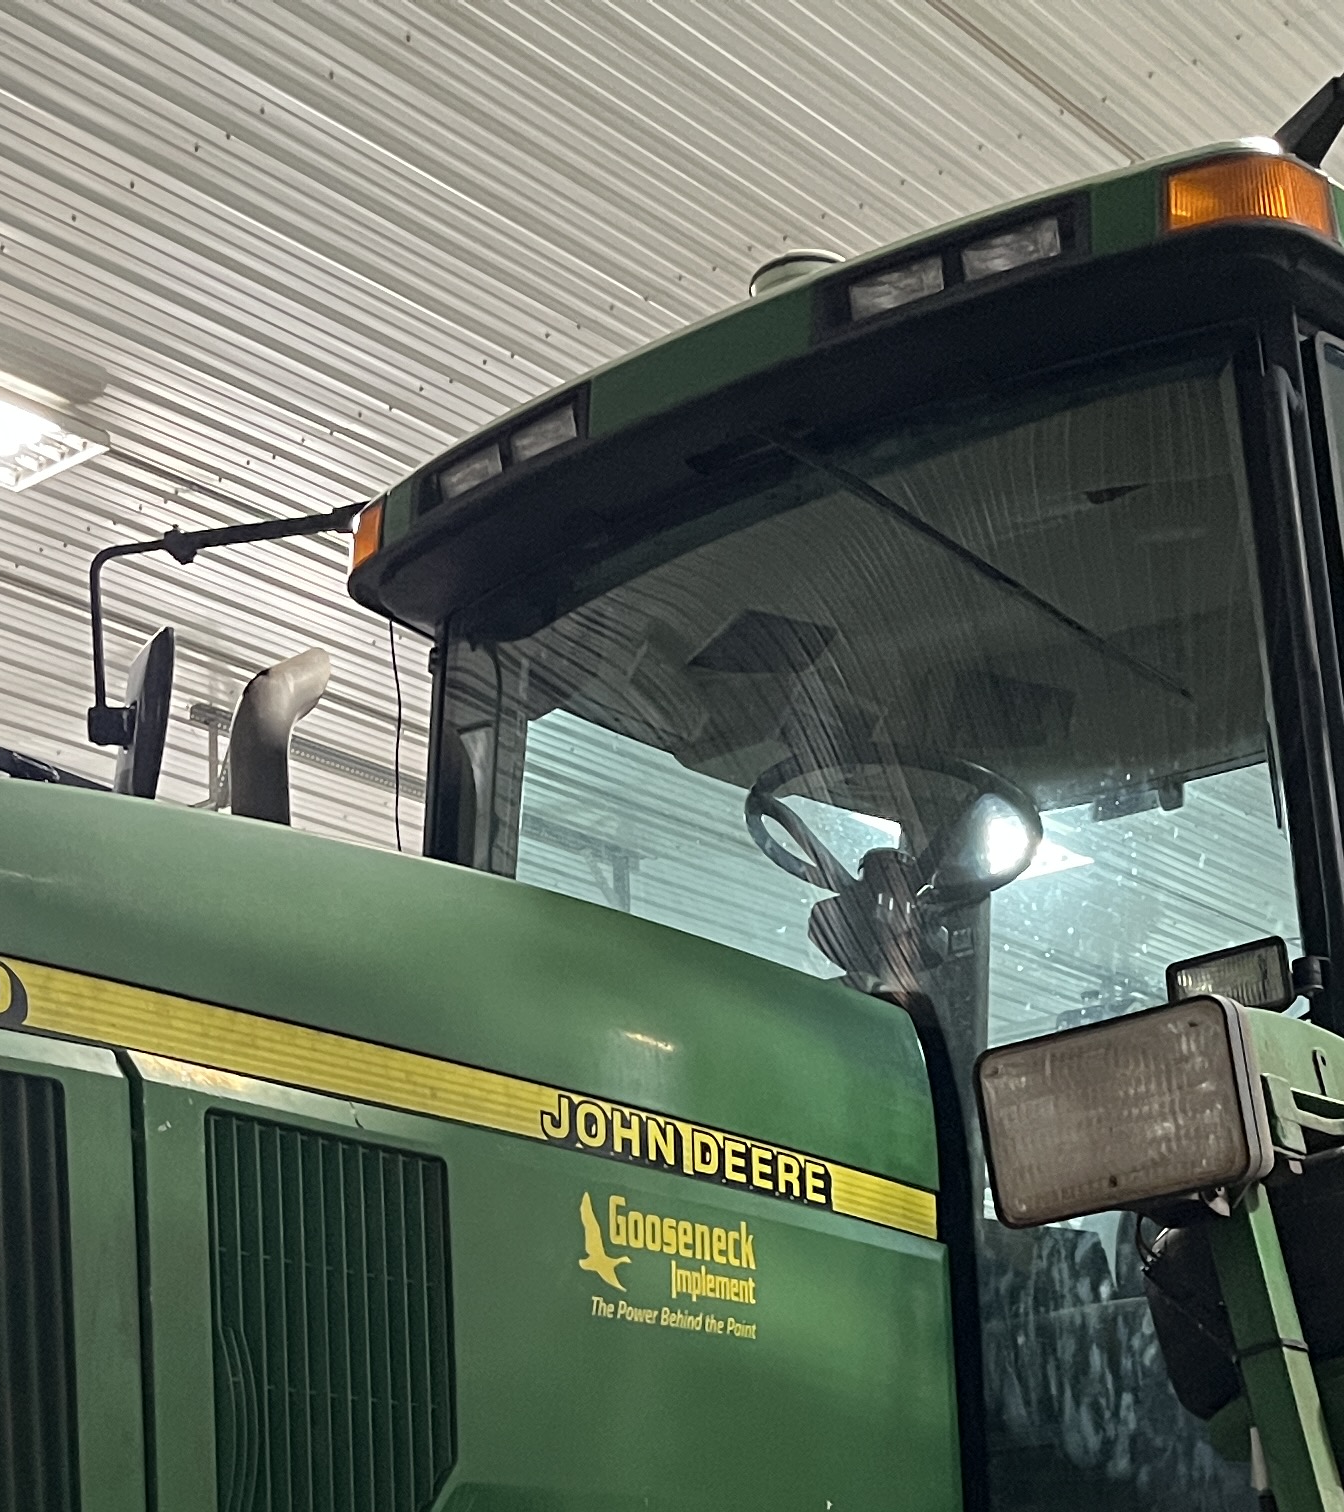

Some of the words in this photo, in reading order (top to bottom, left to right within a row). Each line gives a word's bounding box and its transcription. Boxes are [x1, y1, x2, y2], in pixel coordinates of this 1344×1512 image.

[540, 1094, 677, 1169] JOHN
[692, 1130, 828, 1206] DEERE
[609, 1195, 756, 1269] Gooseneck
[671, 1260, 756, 1304] Implement
[591, 1296, 614, 1318] The
[617, 1300, 659, 1325] Power
[660, 1306, 704, 1331] Behind
[705, 1313, 724, 1334] the
